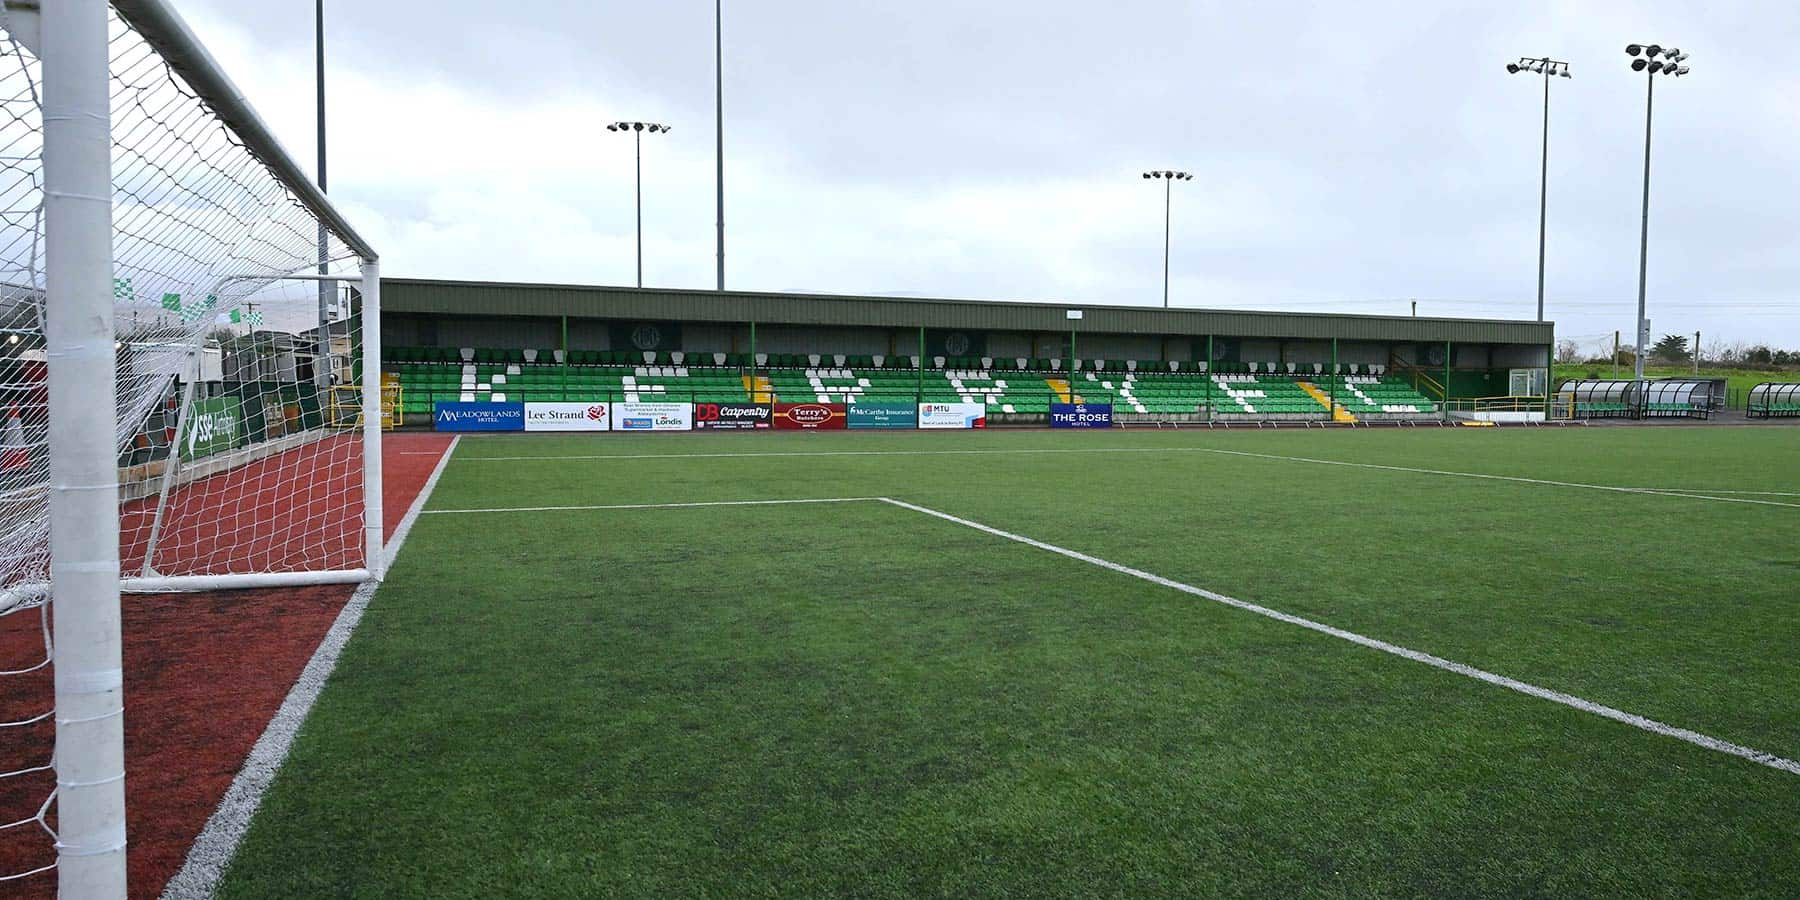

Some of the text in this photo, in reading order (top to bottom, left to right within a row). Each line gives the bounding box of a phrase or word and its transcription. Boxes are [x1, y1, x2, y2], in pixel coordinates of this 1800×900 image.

[438, 409, 520, 421] MEADOWLANDS
[528, 410, 584, 419] Lee Strand
[697, 404, 719, 420] DB
[794, 408, 828, 416] Terry's
[655, 417, 682, 425] Londis
[1053, 414, 1109, 422] THE ROSE
